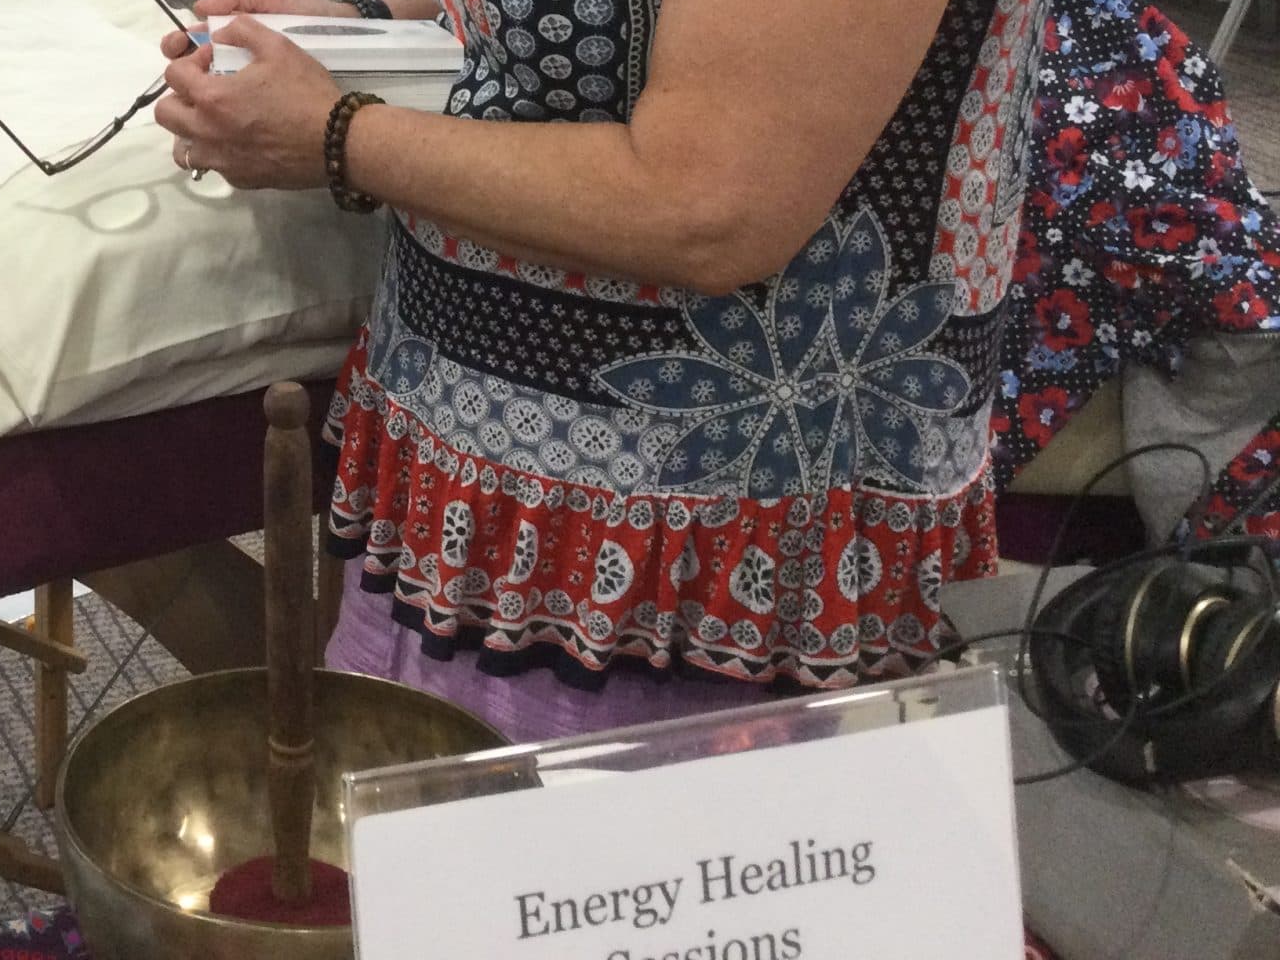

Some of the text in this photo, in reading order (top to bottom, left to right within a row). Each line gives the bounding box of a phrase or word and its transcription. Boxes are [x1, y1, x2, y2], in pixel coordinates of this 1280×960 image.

[514, 839, 876, 939] Energy Healing
[607, 928, 802, 960] ions
